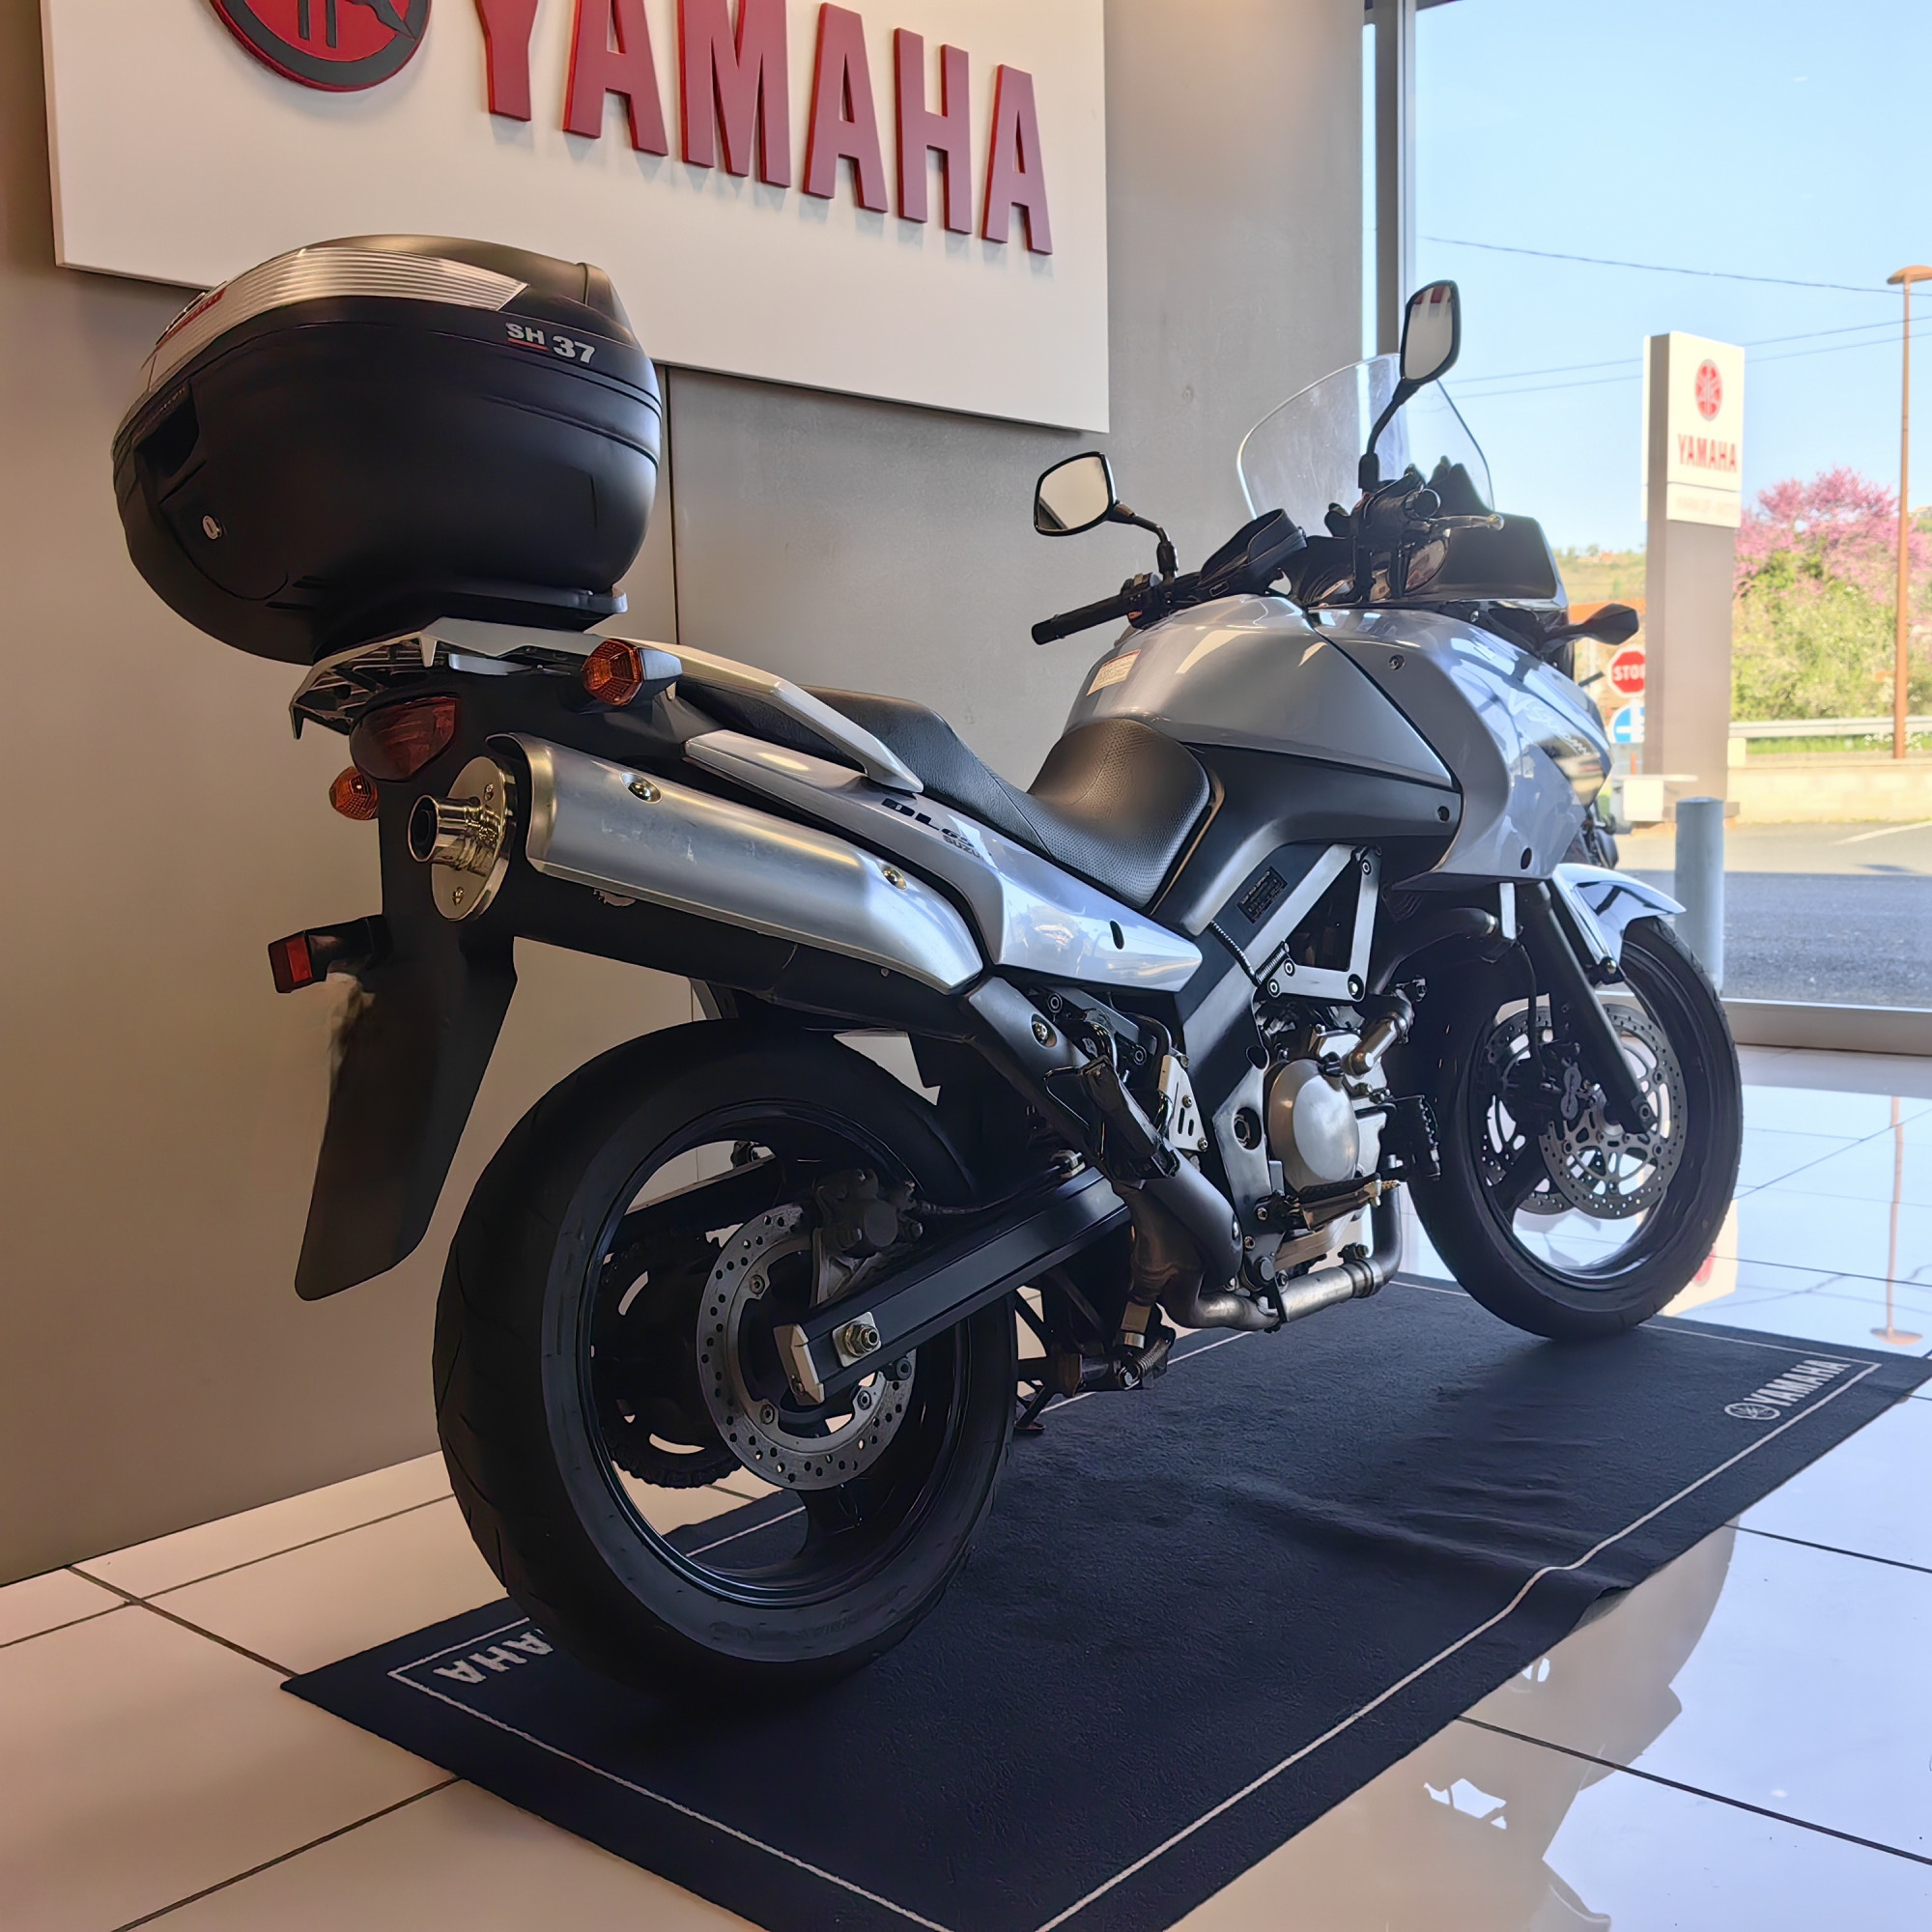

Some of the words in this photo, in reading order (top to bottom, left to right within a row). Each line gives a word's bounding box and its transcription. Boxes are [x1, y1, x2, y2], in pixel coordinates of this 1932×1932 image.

[505, 322, 546, 345] SH
[553, 335, 596, 364] 37
[1677, 433, 1738, 473] YAMAHA
[942, 835, 985, 862] SUZU
[1743, 1359, 1852, 1406] YAMAHA
[432, 1628, 554, 1684] AHA
